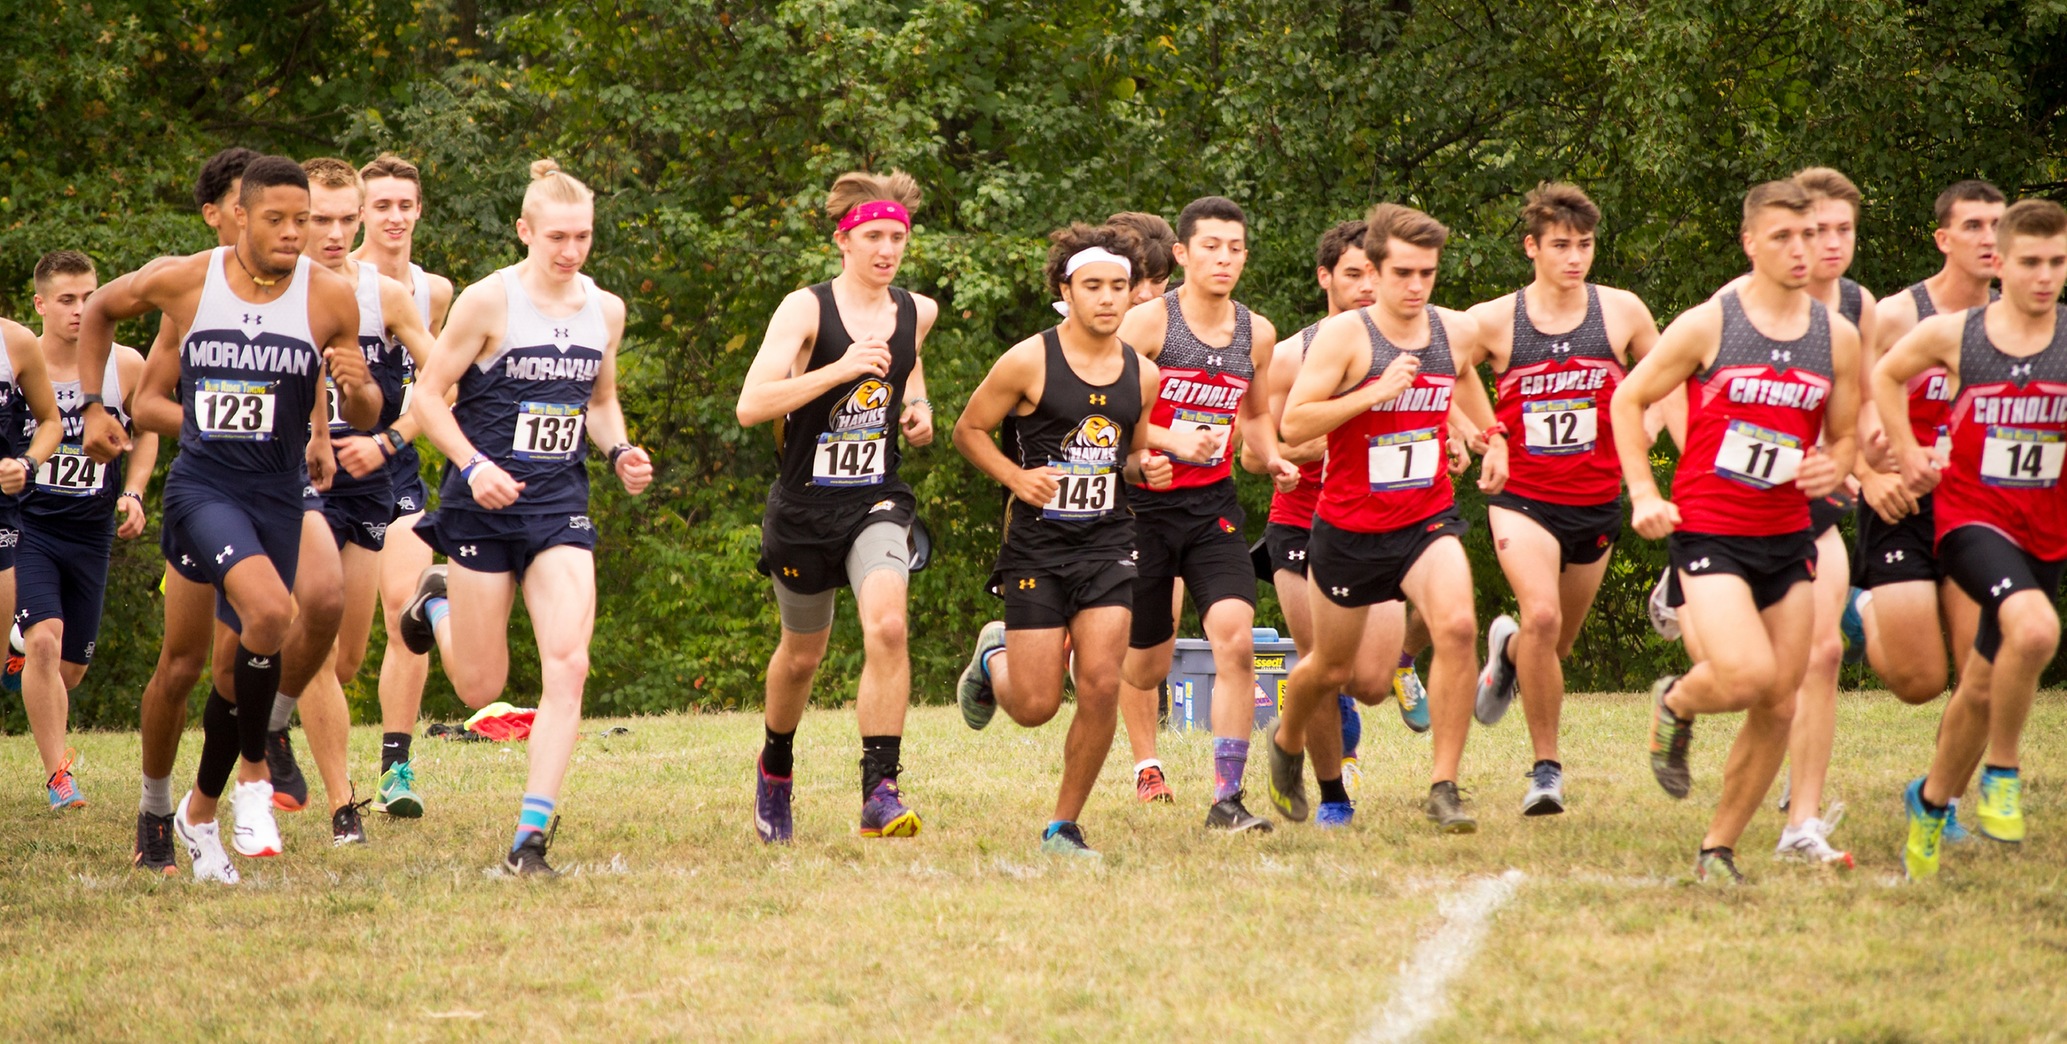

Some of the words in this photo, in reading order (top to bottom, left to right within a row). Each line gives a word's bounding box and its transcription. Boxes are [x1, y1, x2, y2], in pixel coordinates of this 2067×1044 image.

[188, 340, 311, 377] MORAVIAN
[1160, 377, 1244, 410] CATHOLIC
[1728, 377, 1825, 411] CATHOLIC
[204, 394, 263, 431] 123
[837, 406, 887, 429] HAWKS
[1543, 412, 1578, 445] 12
[525, 417, 577, 452] 133
[825, 442, 877, 476] 142
[1069, 446, 1118, 461] HAWKS
[1398, 445, 1413, 479] 7
[1745, 442, 1779, 479] 11
[2007, 443, 2043, 477] 14
[45, 455, 96, 487] 124
[1058, 476, 1107, 510] 143
